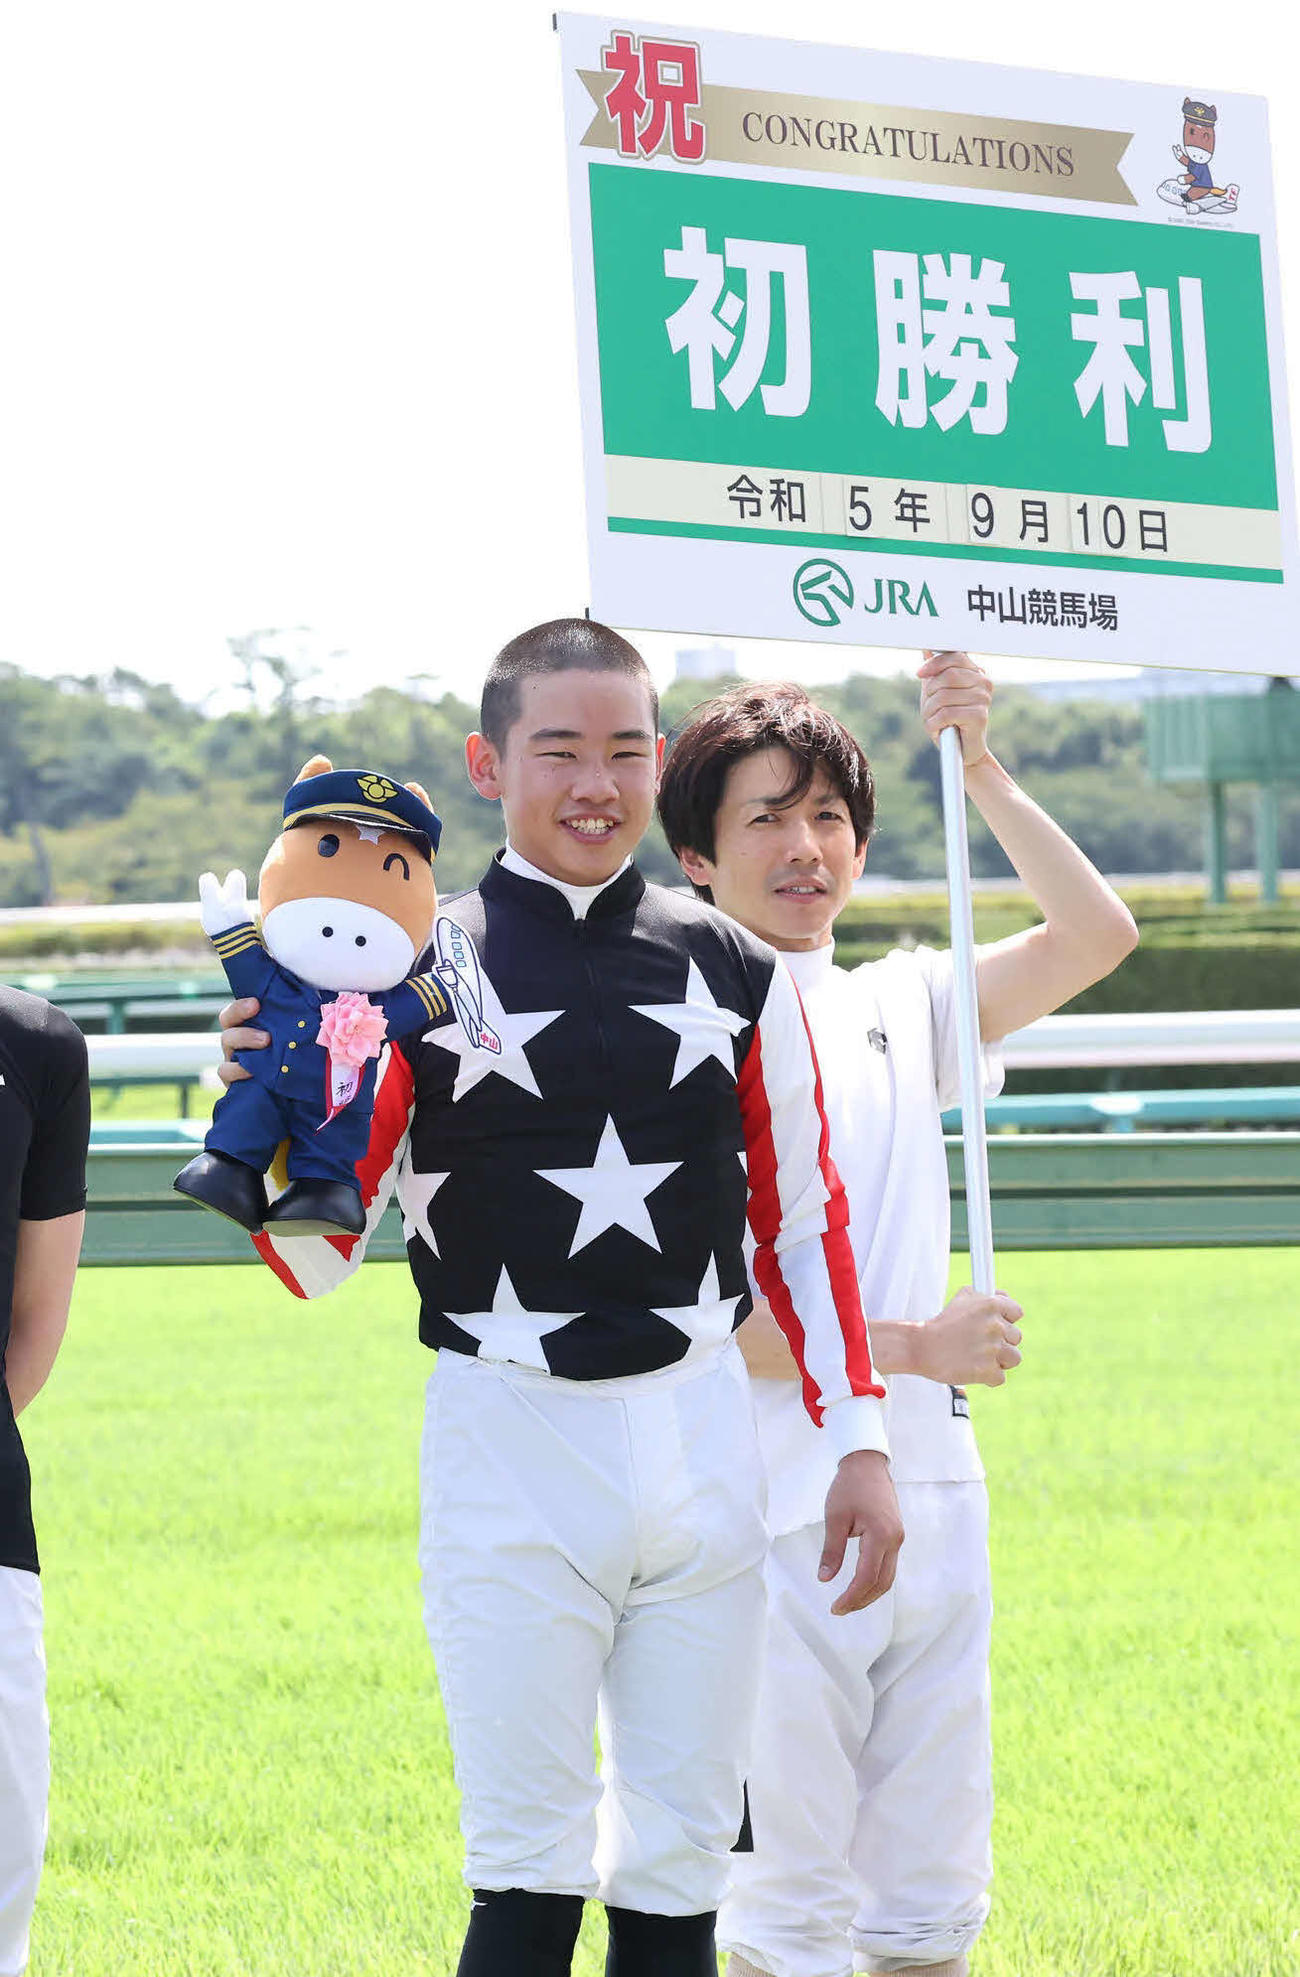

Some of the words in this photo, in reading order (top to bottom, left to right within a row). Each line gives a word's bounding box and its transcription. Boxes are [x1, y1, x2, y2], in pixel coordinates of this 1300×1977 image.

[605, 35, 704, 160] 祝
[742, 112, 1075, 177] CONGRATULATIONS
[664, 226, 1212, 454] 初勝利
[864, 578, 940, 618] JRA
[967, 584, 1118, 631] 中山競馬場
[479, 1032, 499, 1050] 中山
